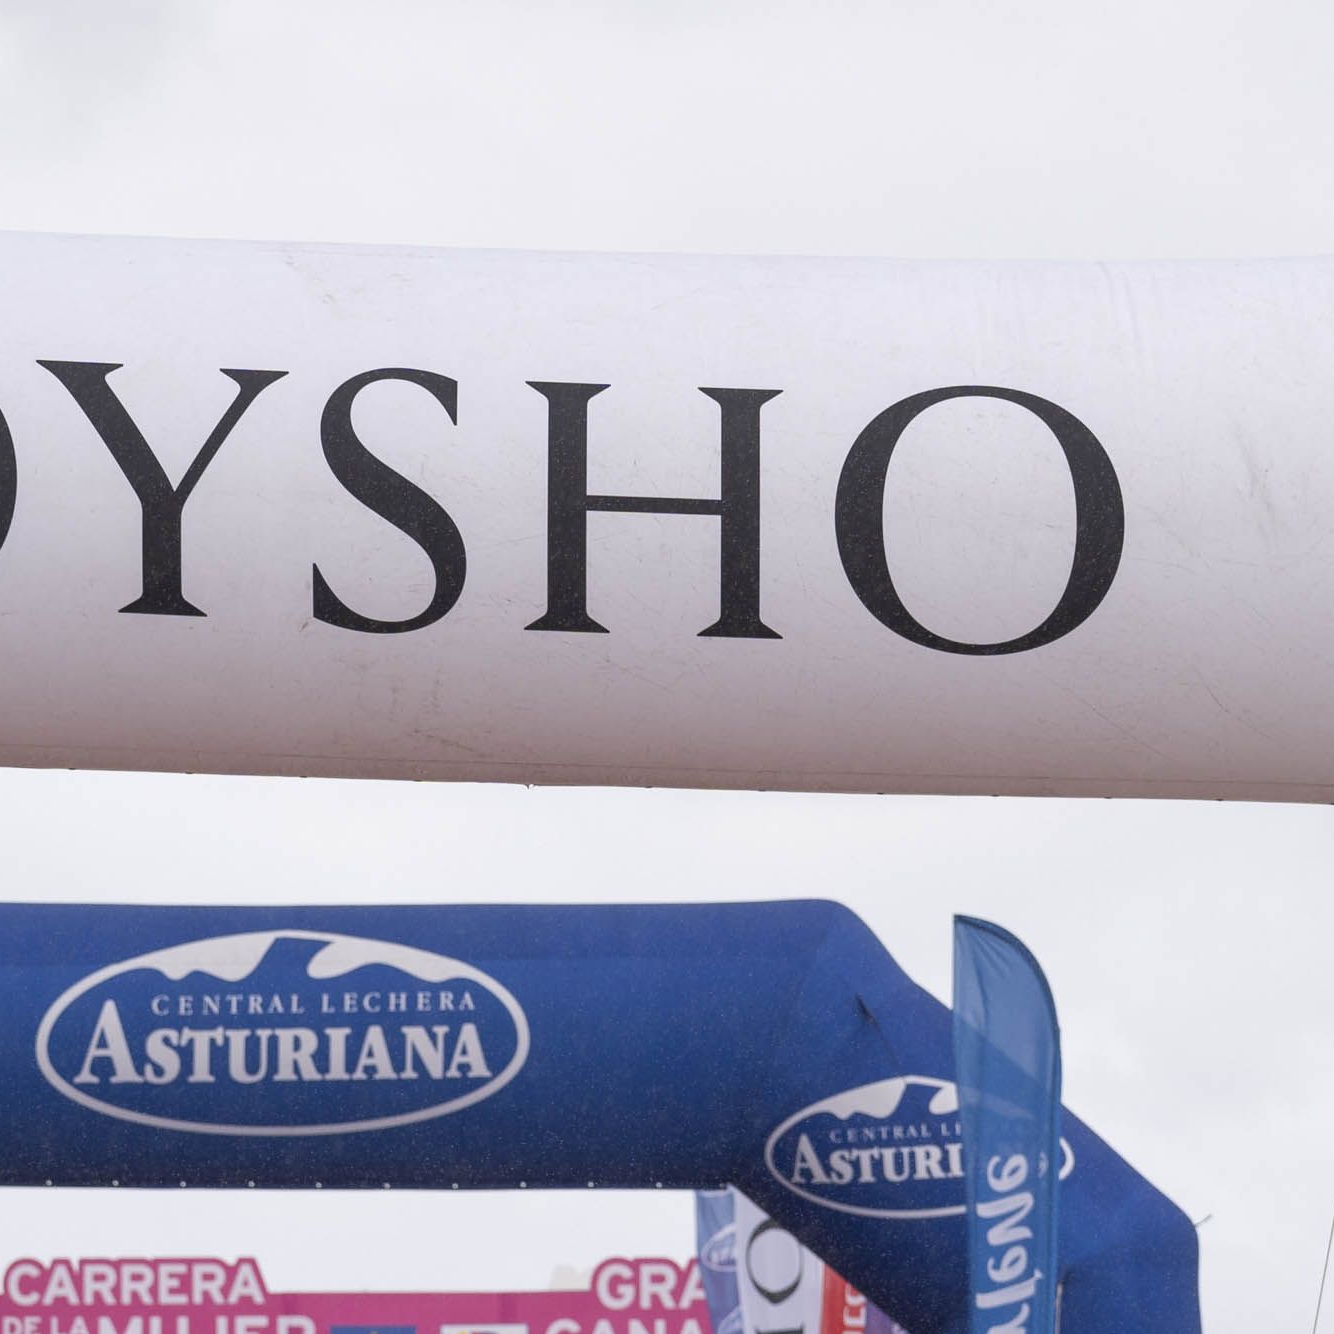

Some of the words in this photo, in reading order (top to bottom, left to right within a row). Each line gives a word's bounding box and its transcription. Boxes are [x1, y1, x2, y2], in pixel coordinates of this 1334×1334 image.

[151, 993, 306, 1016] CENTRAL
[321, 991, 476, 1012] LECHERA
[73, 1000, 492, 1084] ASTURIANA
[828, 1124, 932, 1144] CENTRAL
[790, 1132, 964, 1184] ASTURI
[6, 1262, 266, 1307] CARRERA
[596, 1263, 708, 1311] GRA
